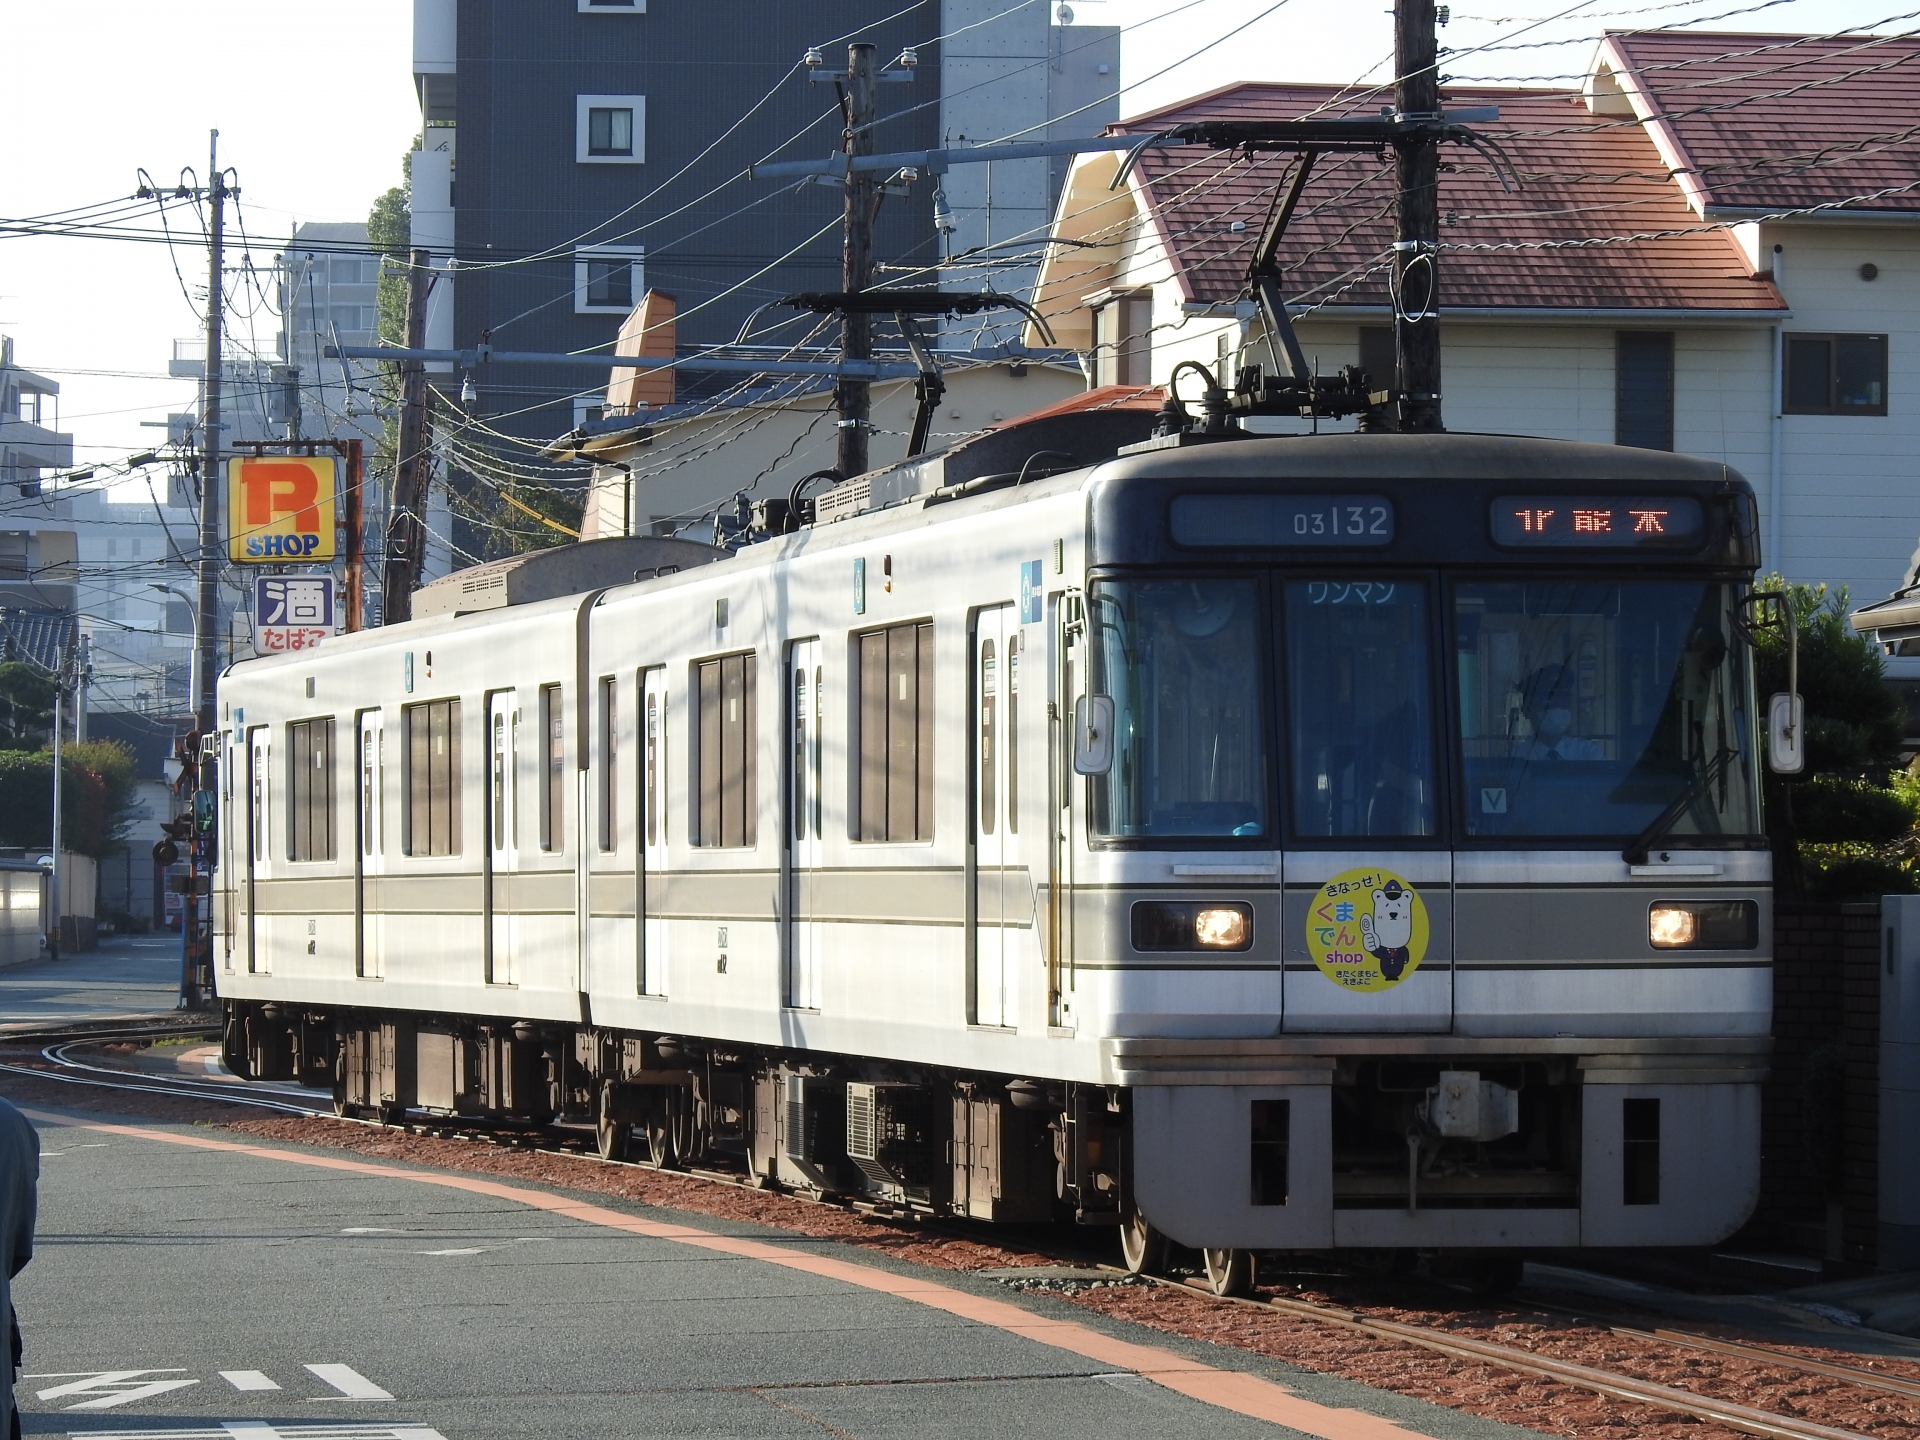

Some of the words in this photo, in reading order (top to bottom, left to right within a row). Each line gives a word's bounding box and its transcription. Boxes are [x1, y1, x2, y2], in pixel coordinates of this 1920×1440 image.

[1293, 506, 1388, 535] 03132
[246, 534, 320, 556] SHOP
[266, 581, 325, 625] 酒
[1308, 581, 1395, 604] ワンマン
[1484, 790, 1503, 811] V
[1316, 901, 1355, 923] くま
[1314, 925, 1356, 947] でん
[1326, 950, 1364, 965] shop
[1335, 970, 1379, 978] きたくまもと
[1342, 978, 1371, 986] えきよこ
